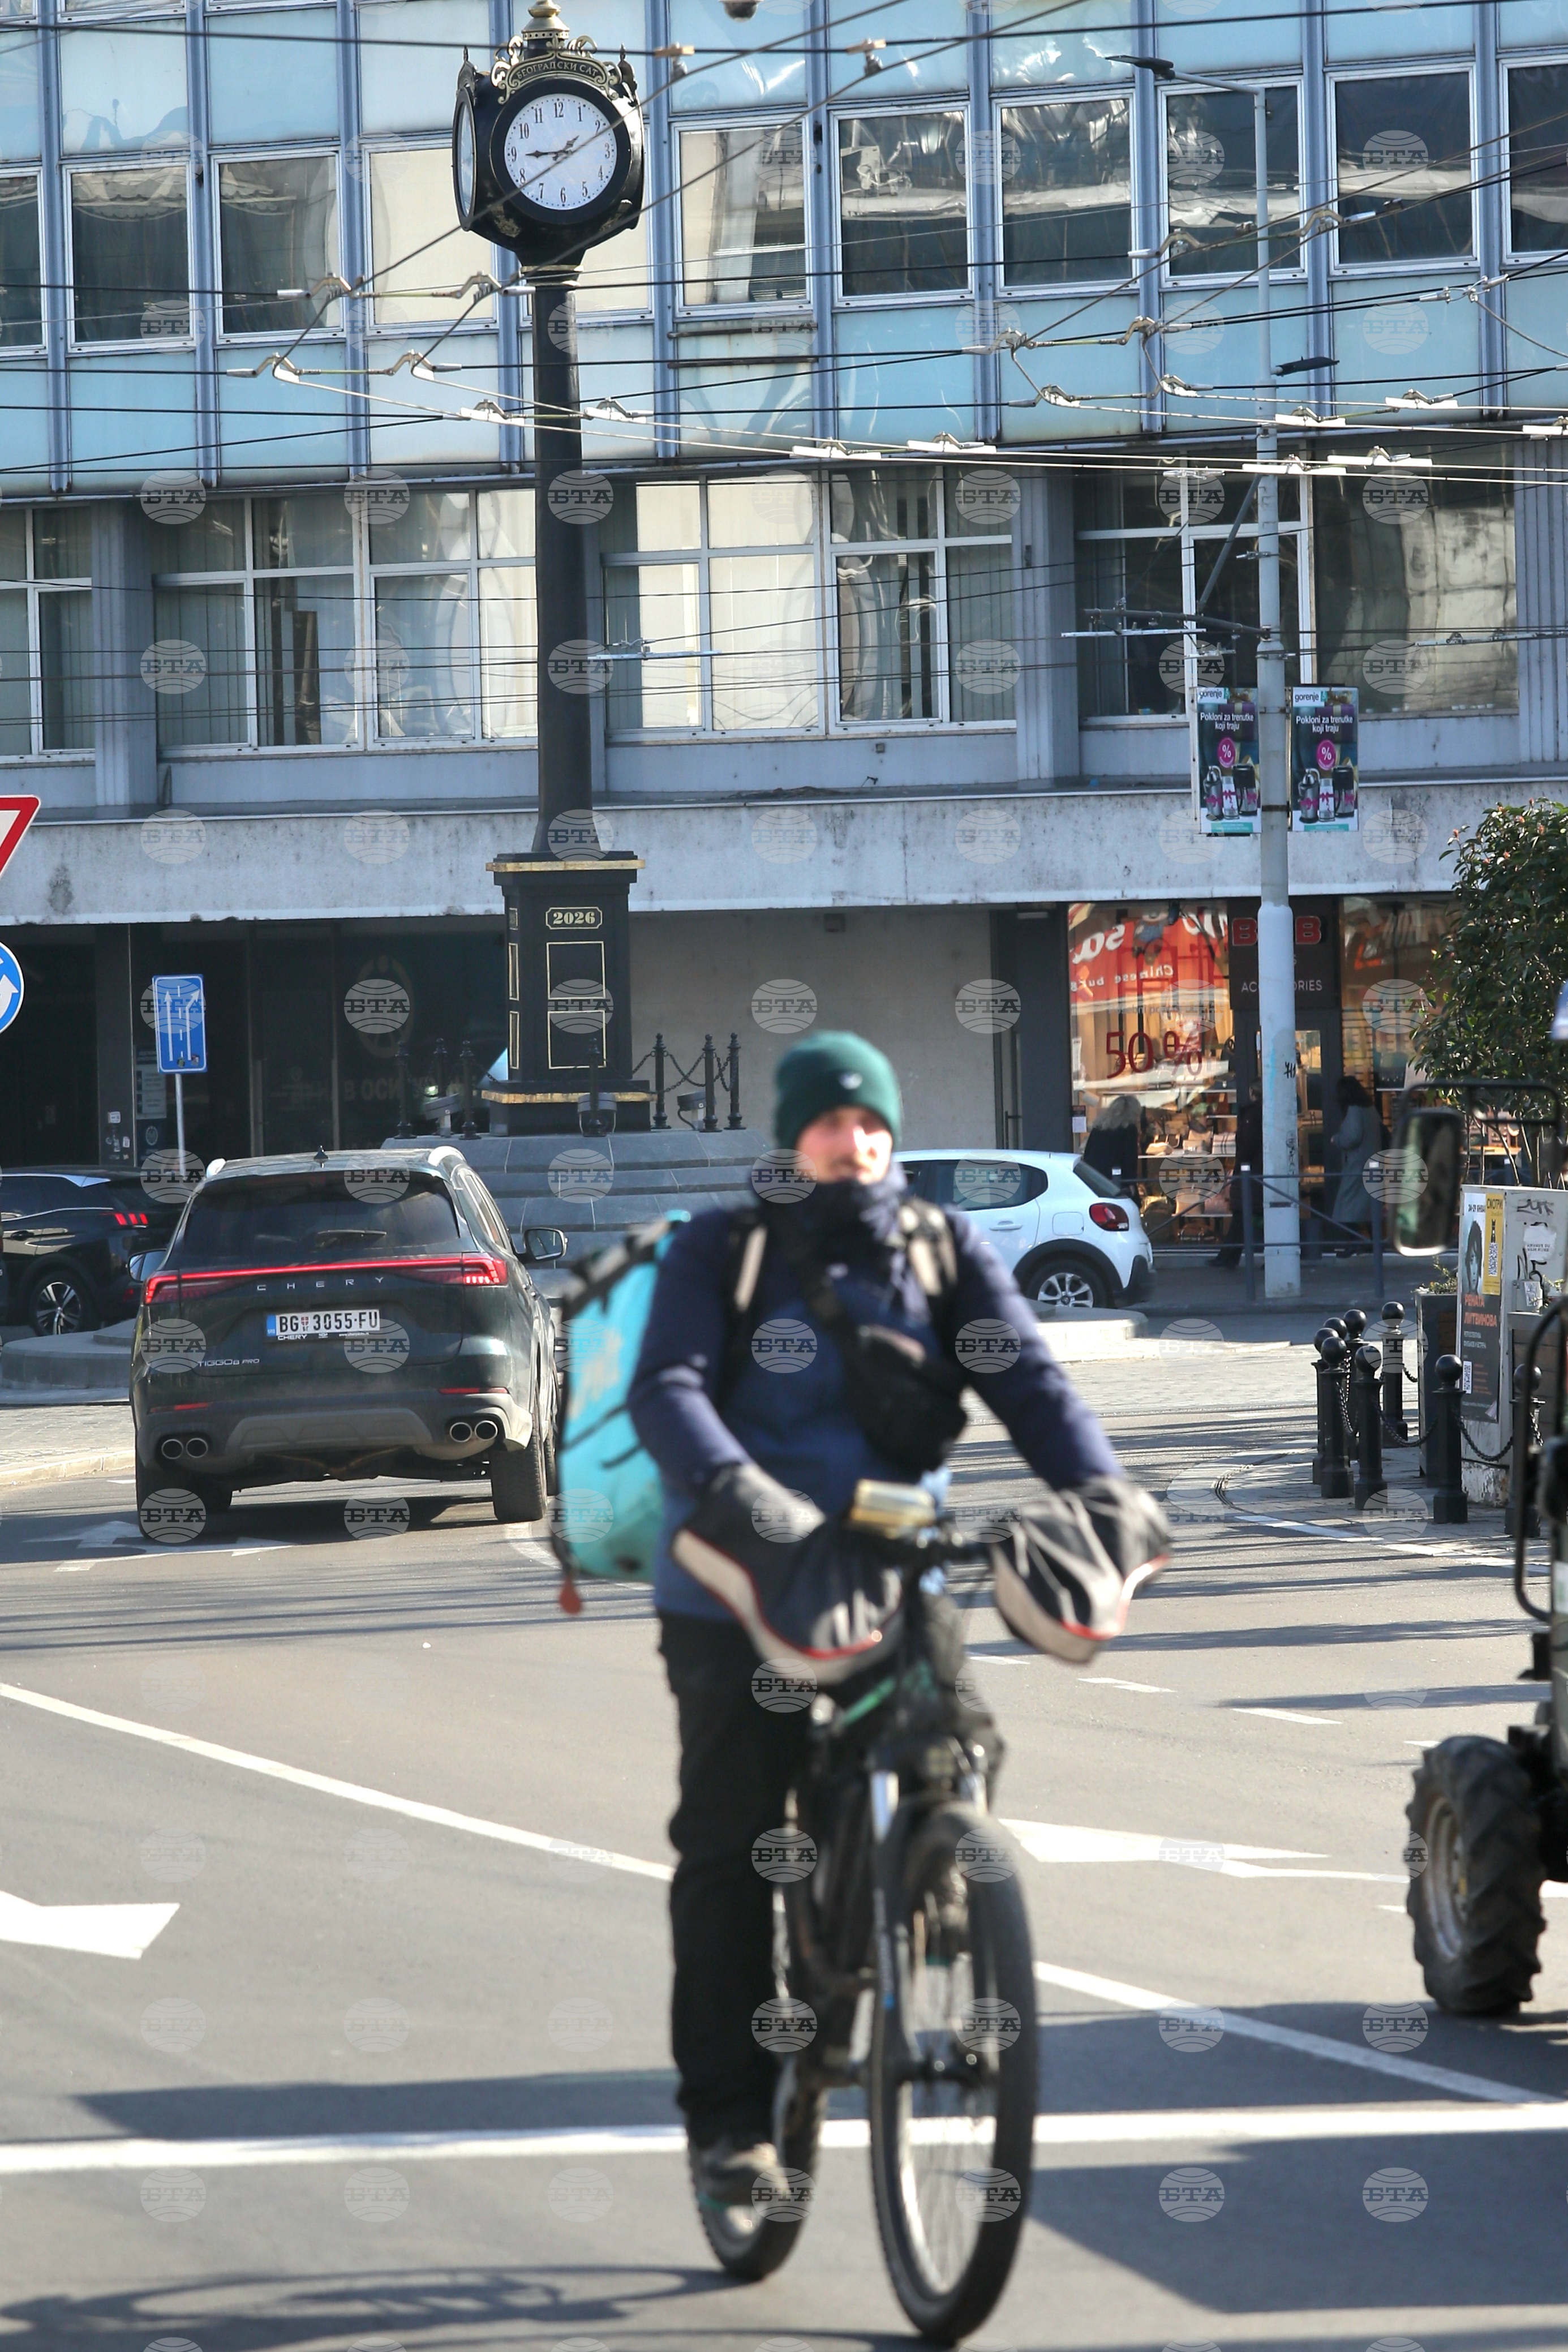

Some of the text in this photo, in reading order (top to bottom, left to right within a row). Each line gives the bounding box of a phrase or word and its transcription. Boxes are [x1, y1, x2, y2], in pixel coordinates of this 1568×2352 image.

[516, 61, 598, 79] БЕОГРАДСКИ САТ
[534, 108, 543, 123] 11
[553, 101, 564, 118] 12
[578, 106, 582, 122] 1
[519, 123, 530, 139] 10
[595, 120, 600, 135] 2
[511, 147, 517, 162] 9
[605, 143, 610, 158] 3
[519, 168, 526, 183] 8
[598, 165, 603, 181] 4
[539, 183, 544, 199] 7
[560, 187, 566, 203] 6
[582, 181, 588, 197] 5
[1200, 689, 1222, 699] gorenje
[1295, 692, 1319, 702] gorenje
[1200, 713, 1222, 721] Pokloni
[1232, 713, 1253, 722] trenutke
[1296, 715, 1321, 724] Pokloni
[1215, 722, 1240, 732] koji traju
[1312, 724, 1339, 735] koji traju
[1222, 744, 1231, 758] %
[1322, 747, 1331, 760] %
[553, 912, 595, 925] 2026
[1232, 916, 1321, 946] BB
[257, 1277, 384, 1291] CHERY
[279, 1316, 299, 1333] BG
